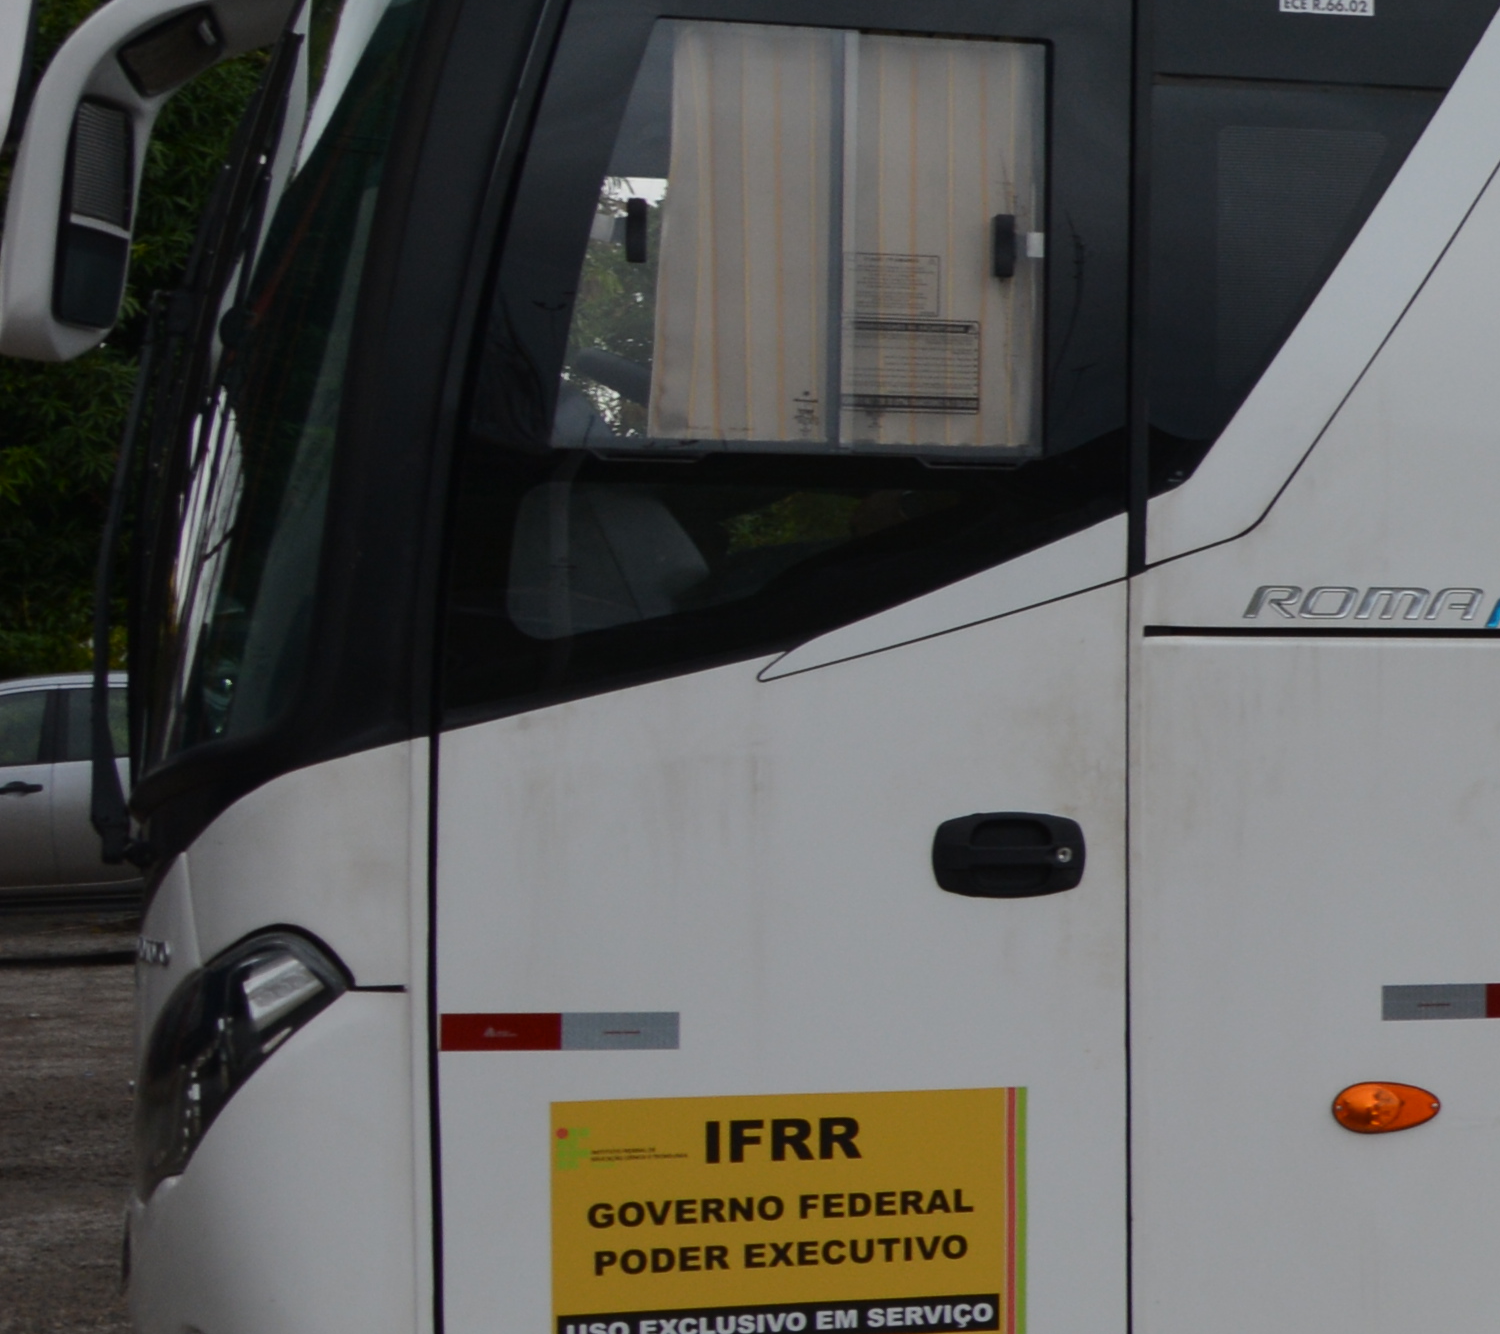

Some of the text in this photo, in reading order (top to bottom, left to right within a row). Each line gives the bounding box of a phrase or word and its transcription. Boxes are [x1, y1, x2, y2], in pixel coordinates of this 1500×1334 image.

[1311, 0, 1368, 13] R.66.02
[1244, 585, 1484, 620] ROMA
[705, 1117, 861, 1163] IFRR
[587, 1189, 973, 1228] GOVERNO FEDERAL
[594, 1235, 967, 1276] PODER EXECUTIVO
[816, 1310, 857, 1329] EM
[868, 1303, 993, 1327] SERVIÇO
